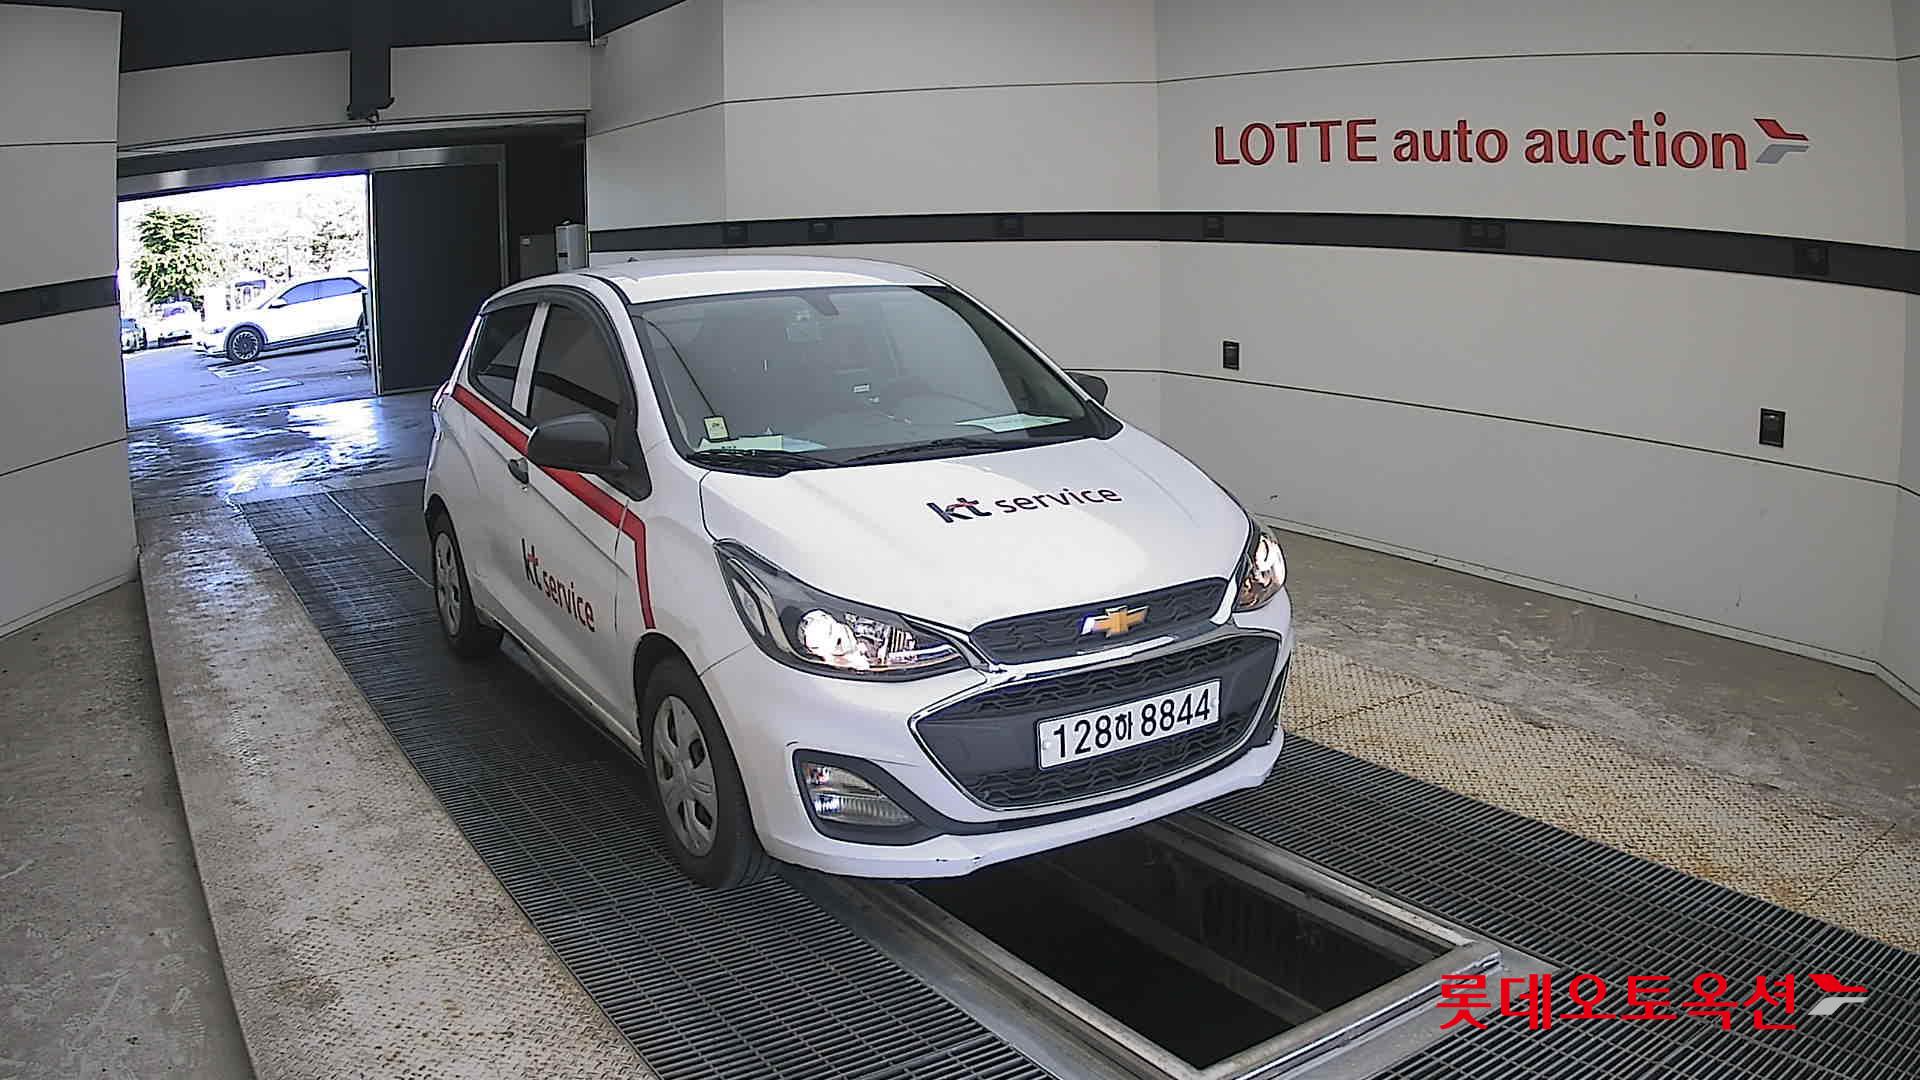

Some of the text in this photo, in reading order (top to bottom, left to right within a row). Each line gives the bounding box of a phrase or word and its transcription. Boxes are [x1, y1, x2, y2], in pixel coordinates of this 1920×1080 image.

[1214, 111, 1748, 171] LOTTE auto auction
[926, 487, 1123, 524] kt service
[521, 537, 596, 633] kt service
[1053, 688, 1211, 759] 128하 8844
